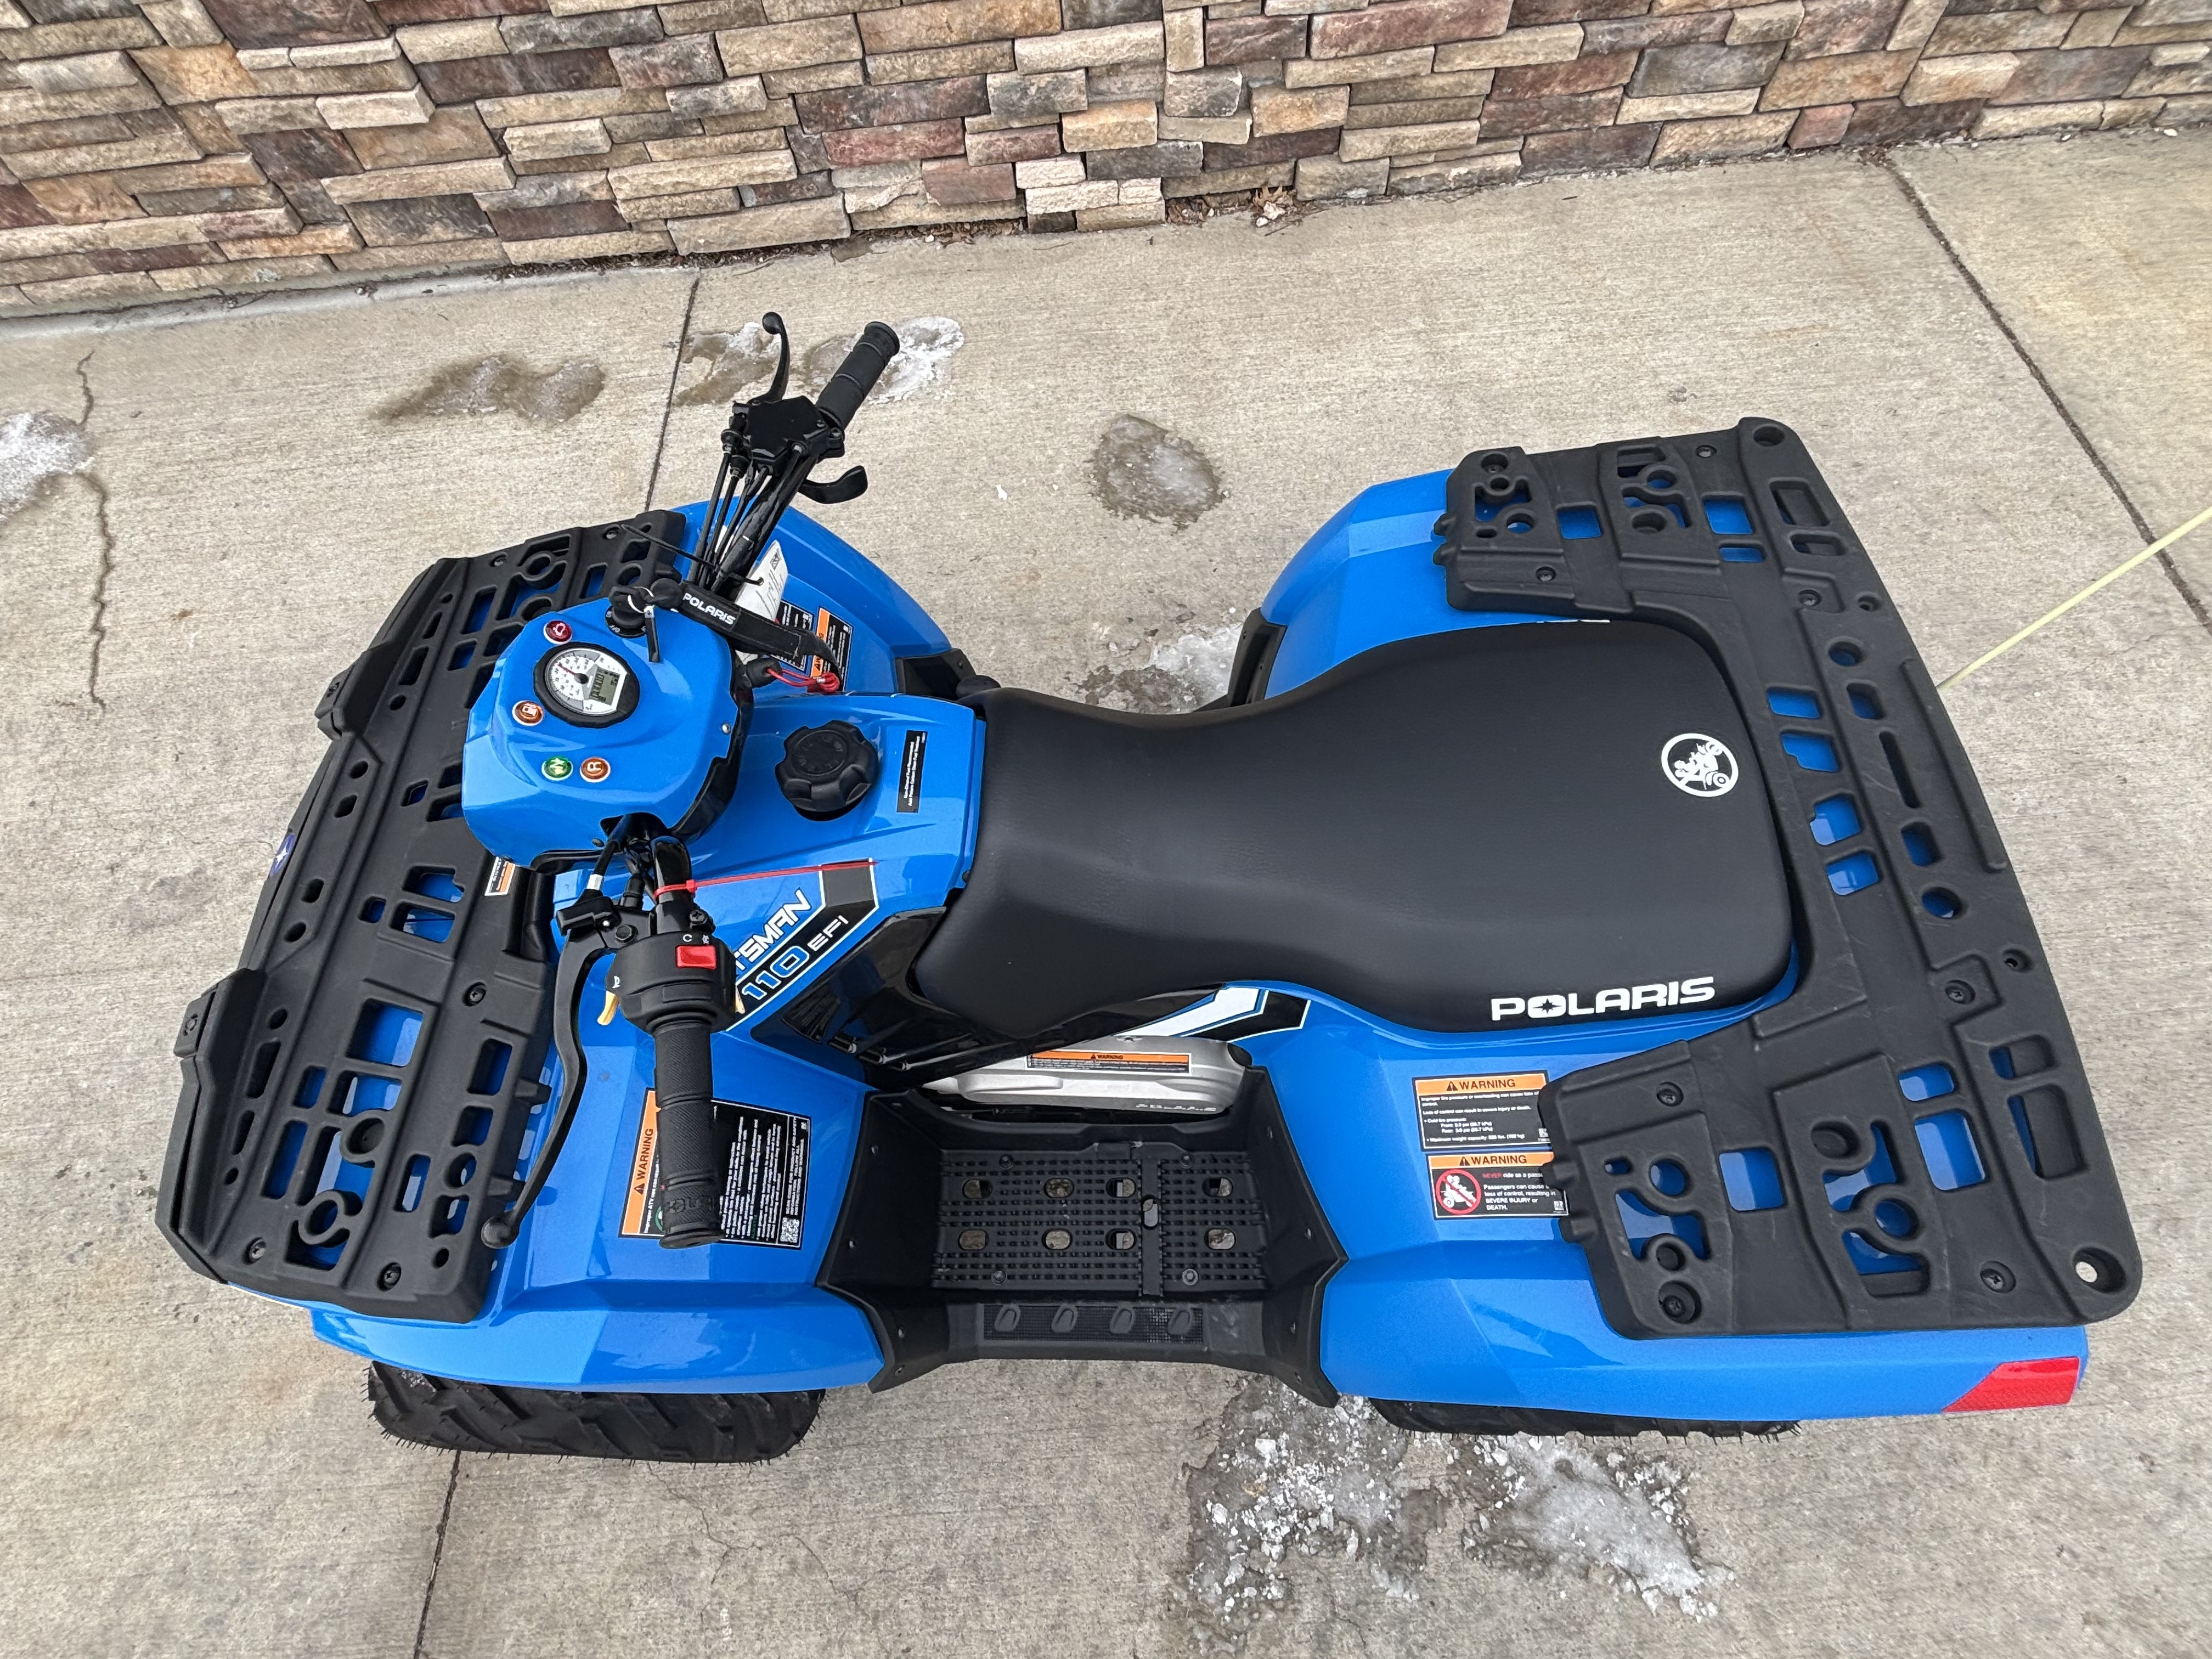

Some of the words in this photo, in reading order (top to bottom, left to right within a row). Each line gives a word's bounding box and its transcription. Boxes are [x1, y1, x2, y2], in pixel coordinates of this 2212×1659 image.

[682, 592, 736, 625] POLARIS
[588, 761, 601, 771] R
[742, 945, 810, 1000] 110
[807, 915, 849, 952] EFI
[1491, 976, 1715, 1021] POLARIS
[1458, 1078, 1516, 1090] WARNING
[635, 1127, 654, 1181] WARNING
[1470, 1155, 1527, 1165] WARNING
